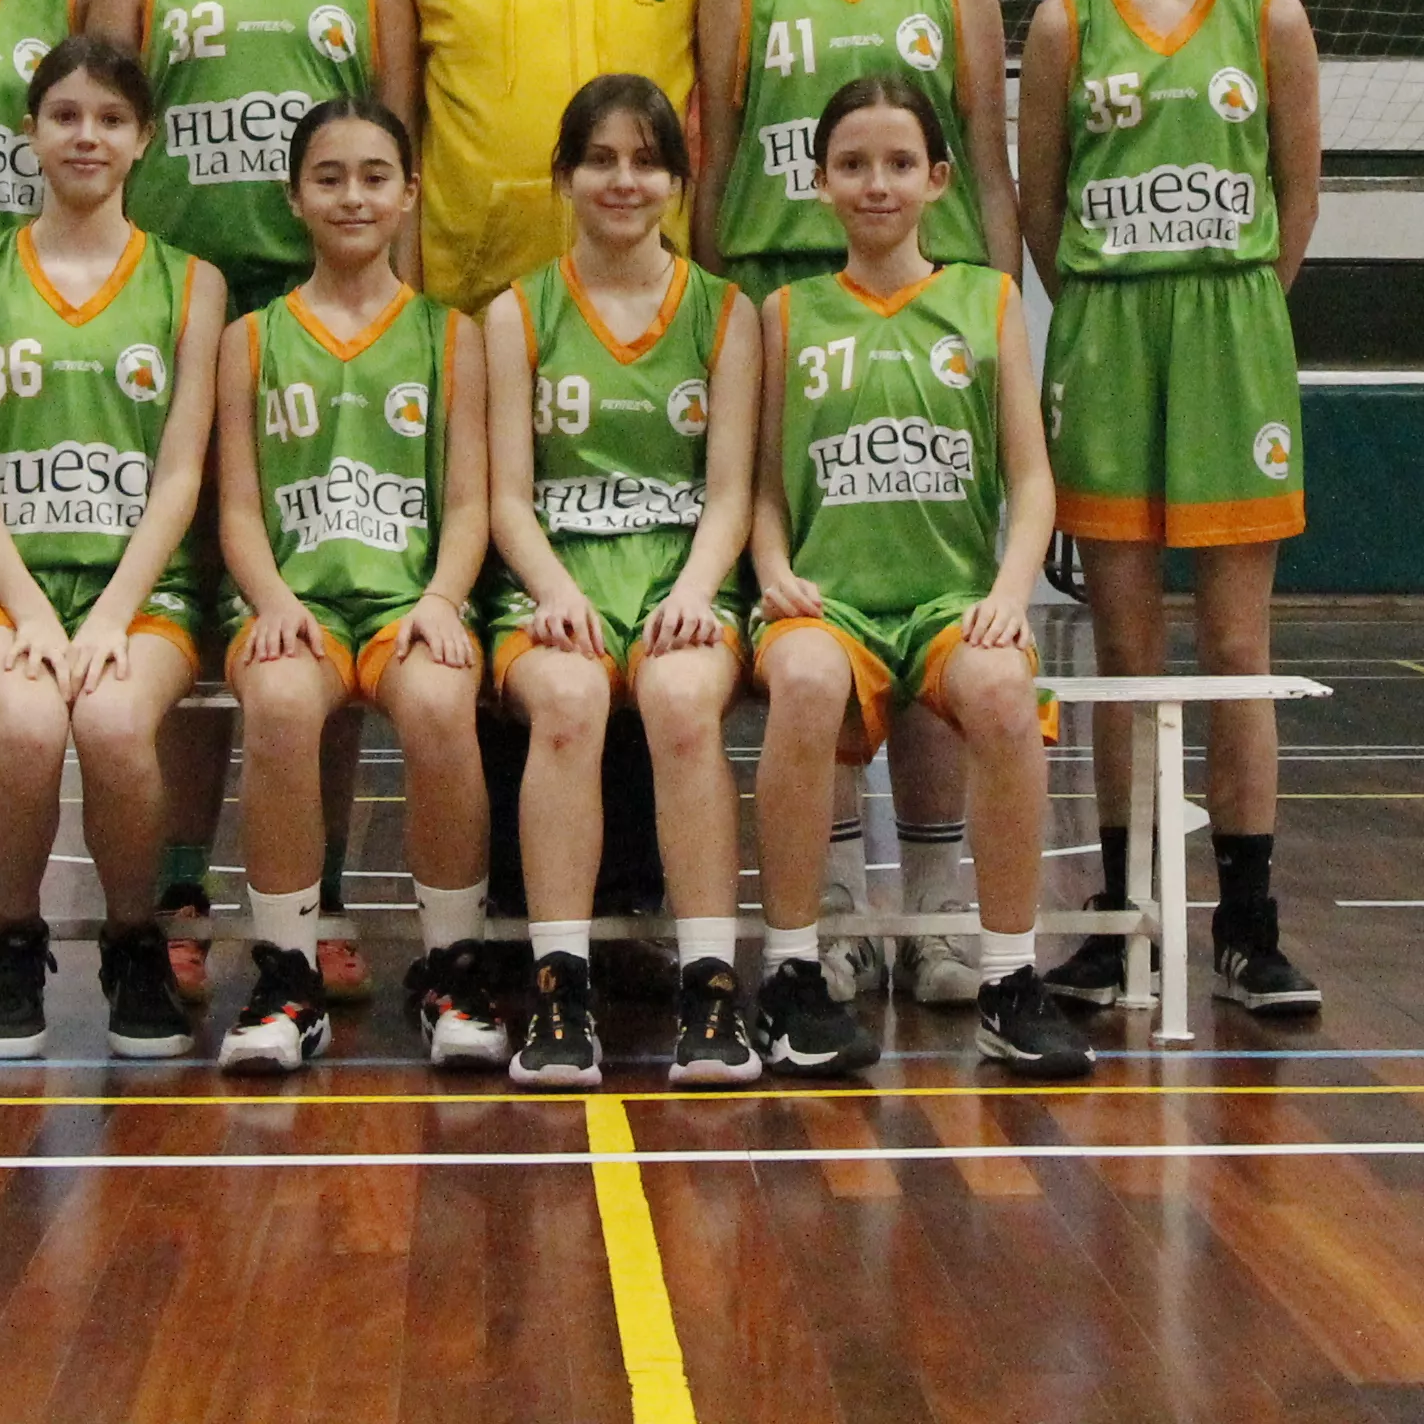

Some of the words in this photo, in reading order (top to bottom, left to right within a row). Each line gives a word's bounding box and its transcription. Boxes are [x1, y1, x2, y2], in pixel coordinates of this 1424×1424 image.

[163, 1, 226, 65] 32
[765, 18, 816, 76] 41
[170, 99, 305, 147] Hues
[1084, 72, 1142, 133] 35
[1087, 171, 1249, 221] Huesca
[798, 336, 856, 400] 37
[266, 383, 319, 443] 40
[534, 375, 590, 435] 39
[817, 424, 971, 480] Huesca
